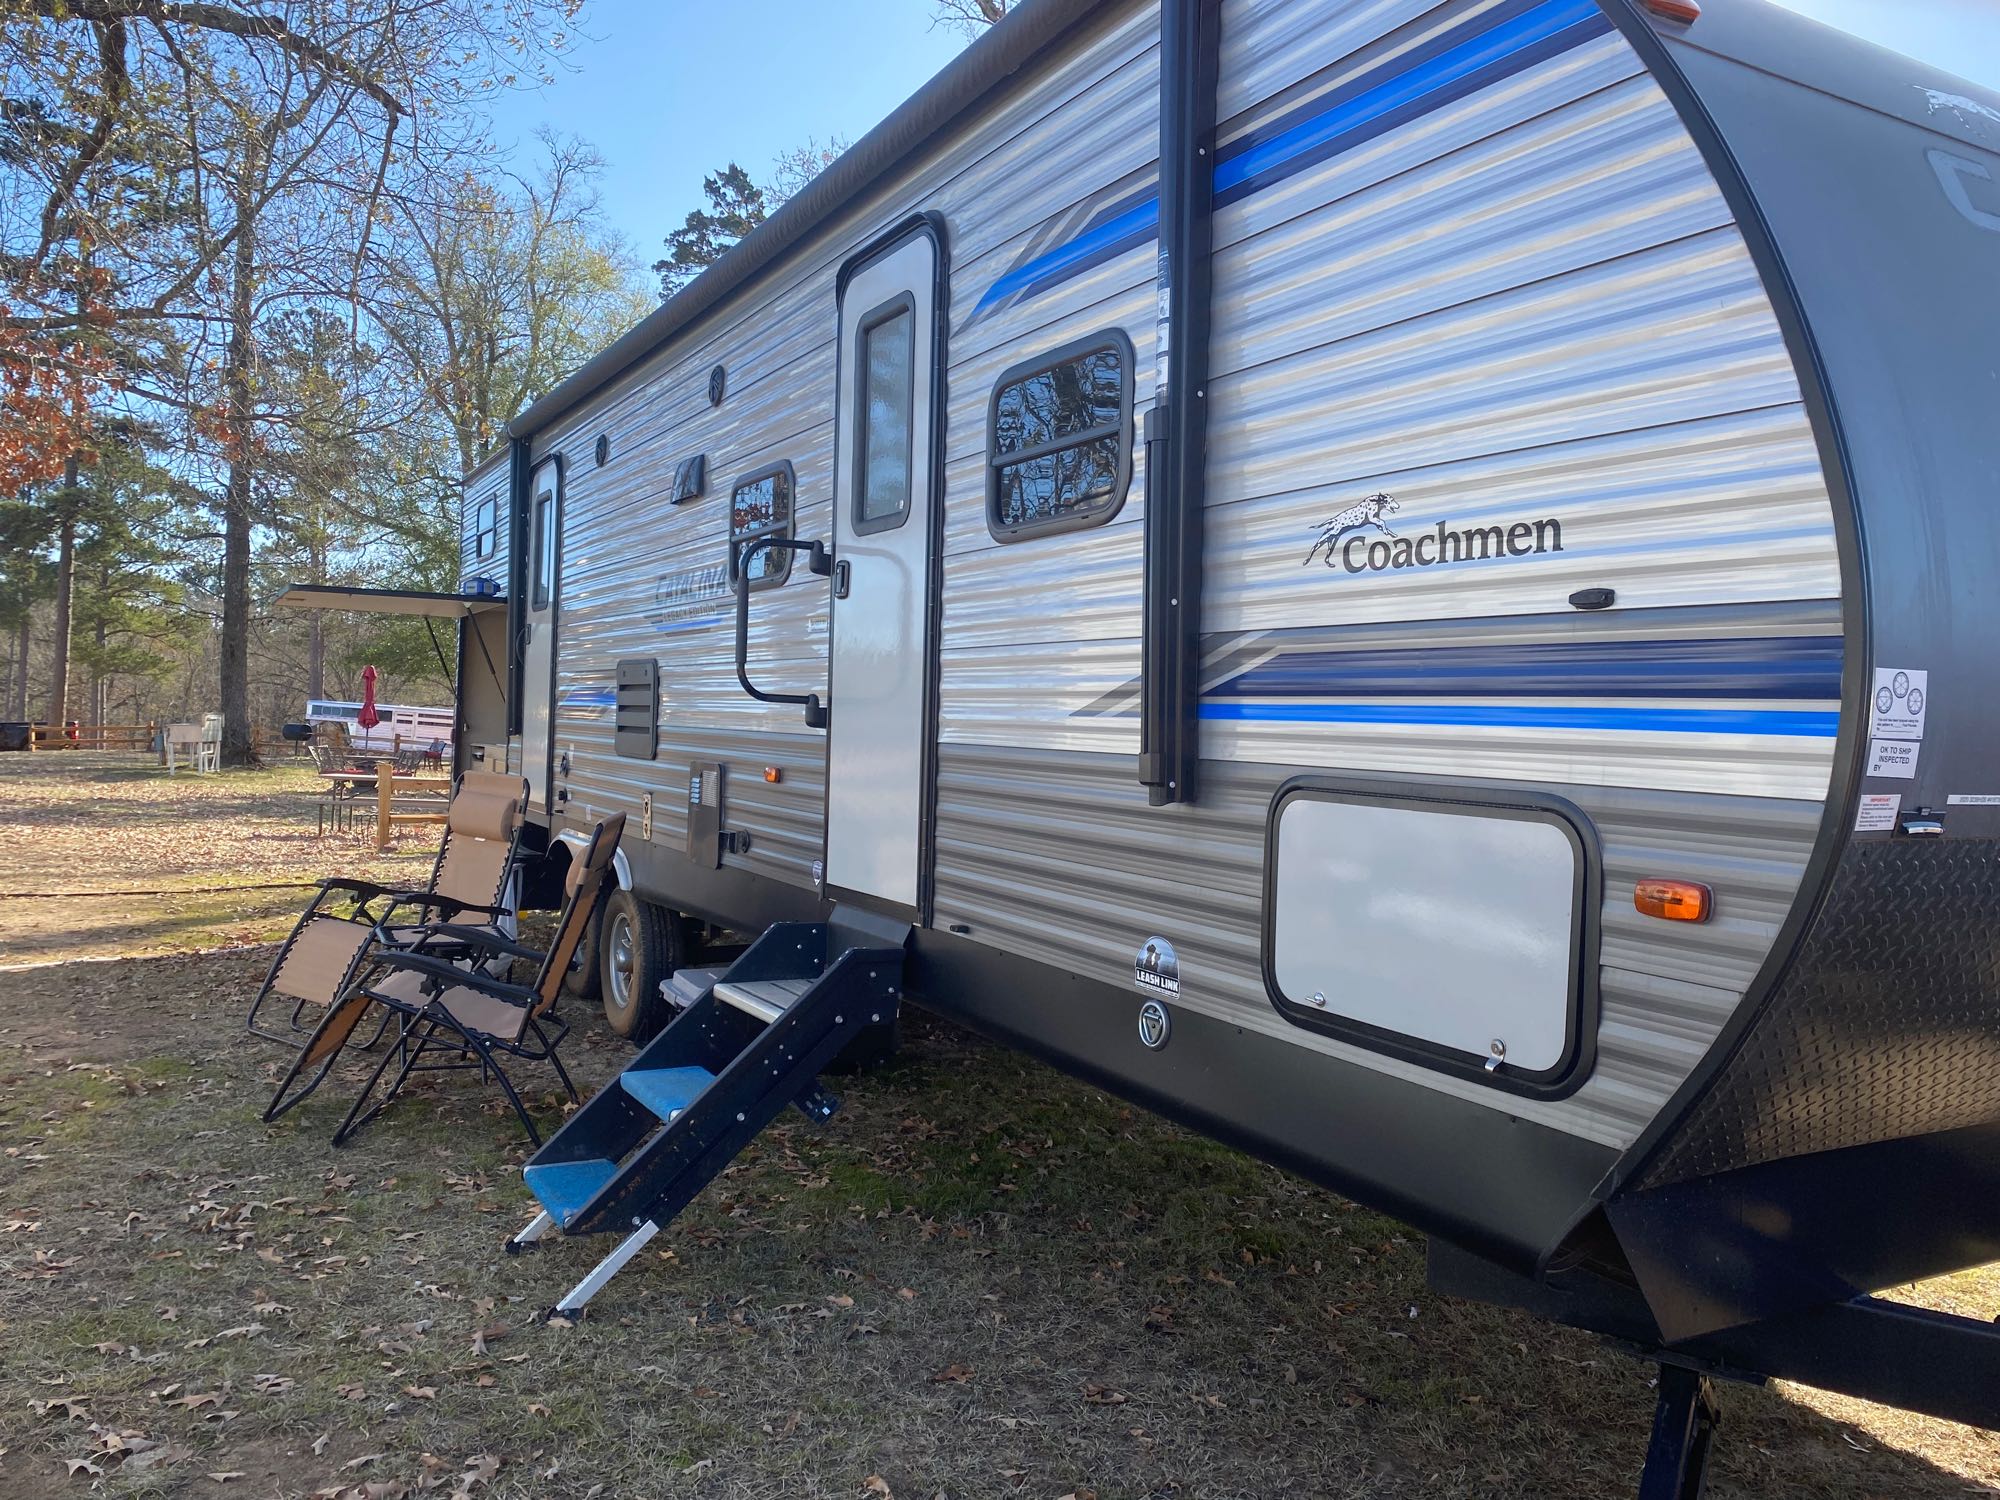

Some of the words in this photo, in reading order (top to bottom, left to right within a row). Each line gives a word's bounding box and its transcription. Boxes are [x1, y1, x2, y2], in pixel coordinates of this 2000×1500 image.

[1342, 517, 1564, 574] Coachmen
[1880, 746, 1889, 754] OK
[1890, 746, 1898, 754] TO
[1898, 747, 1912, 755] SHIP
[1879, 755, 1910, 765] INSPECTED
[1873, 764, 1882, 772] BY
[1136, 969, 1160, 987] LEASH
[1160, 977, 1179, 992] LINK
